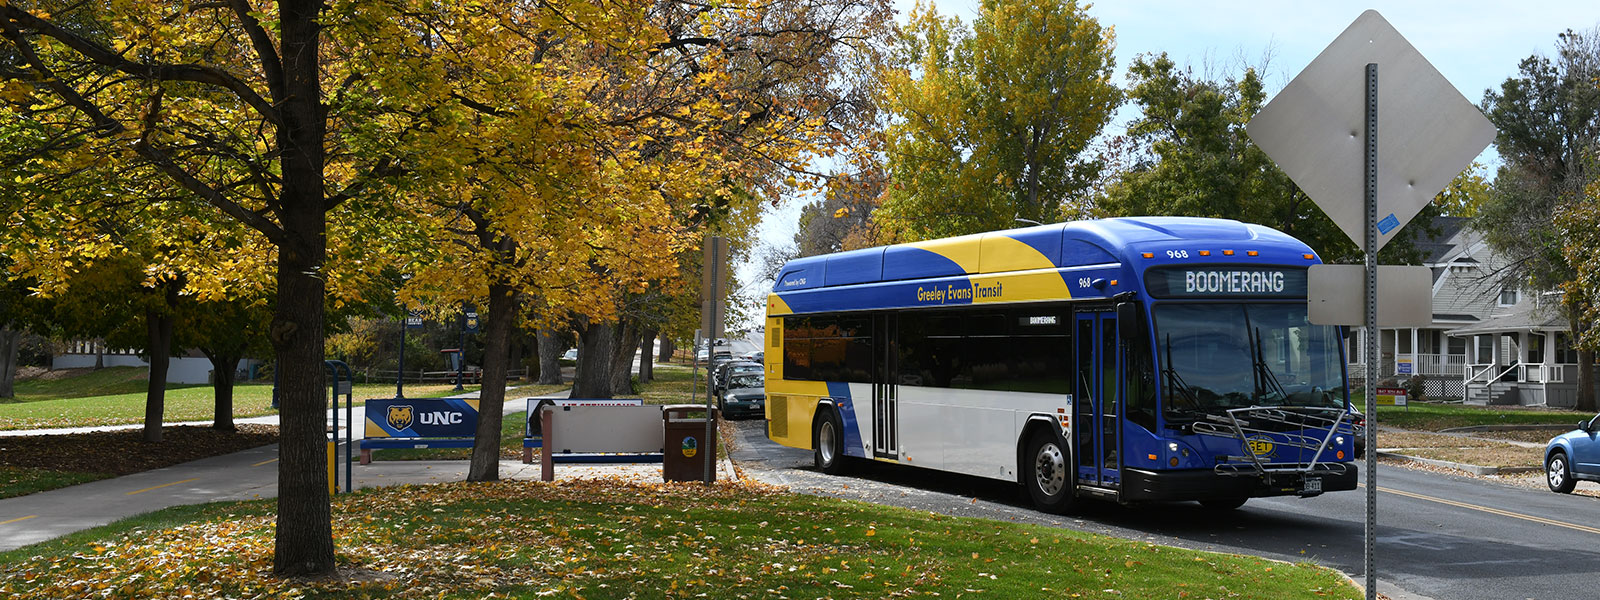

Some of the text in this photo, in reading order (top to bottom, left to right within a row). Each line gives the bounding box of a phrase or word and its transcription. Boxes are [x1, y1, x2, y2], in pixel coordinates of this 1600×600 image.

[1166, 250, 1189, 259] 968
[1078, 277, 1091, 288] 968
[1186, 271, 1284, 293] BOOMERANG
[917, 281, 1003, 304] Greeley Evans Transit
[1029, 316, 1057, 325] BOOMERANG
[420, 411, 463, 425] UNC
[1248, 441, 1269, 451] GET
